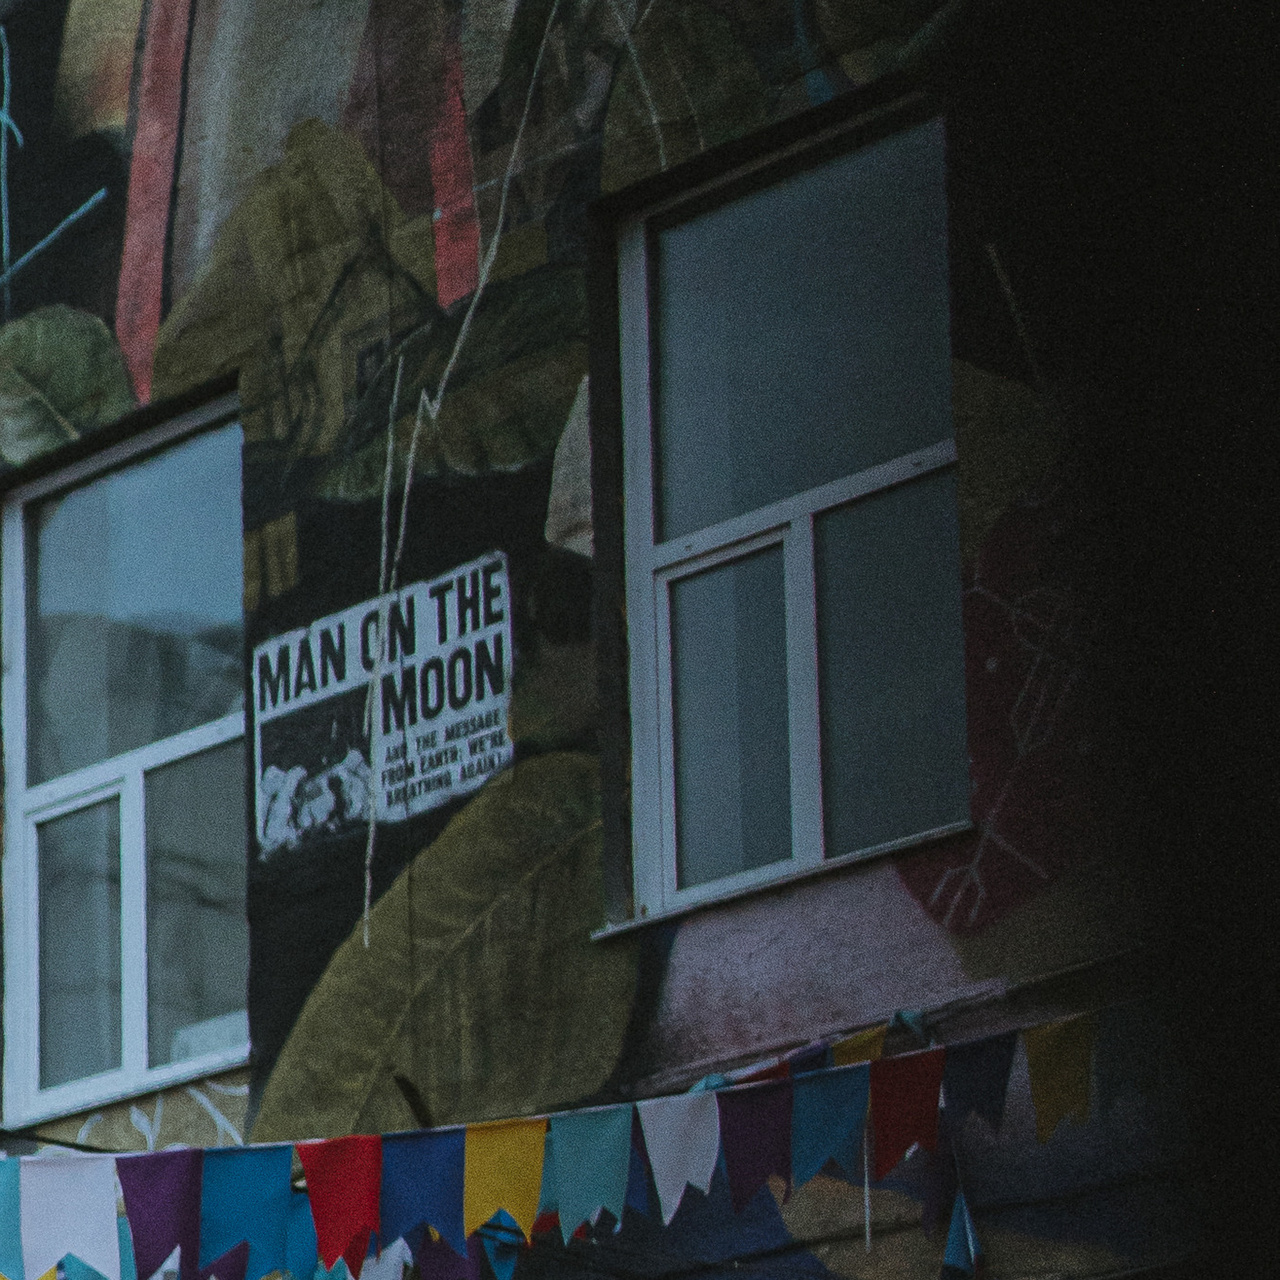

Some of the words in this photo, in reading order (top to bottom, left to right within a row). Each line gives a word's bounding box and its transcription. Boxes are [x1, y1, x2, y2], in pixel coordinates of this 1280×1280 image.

[258, 620, 348, 712] MAN
[359, 594, 417, 671] ON
[429, 558, 505, 645] THE
[380, 631, 506, 735] MOON
[416, 730, 438, 755] THE
[444, 707, 500, 742] MESSAGE
[381, 760, 415, 787] FROM
